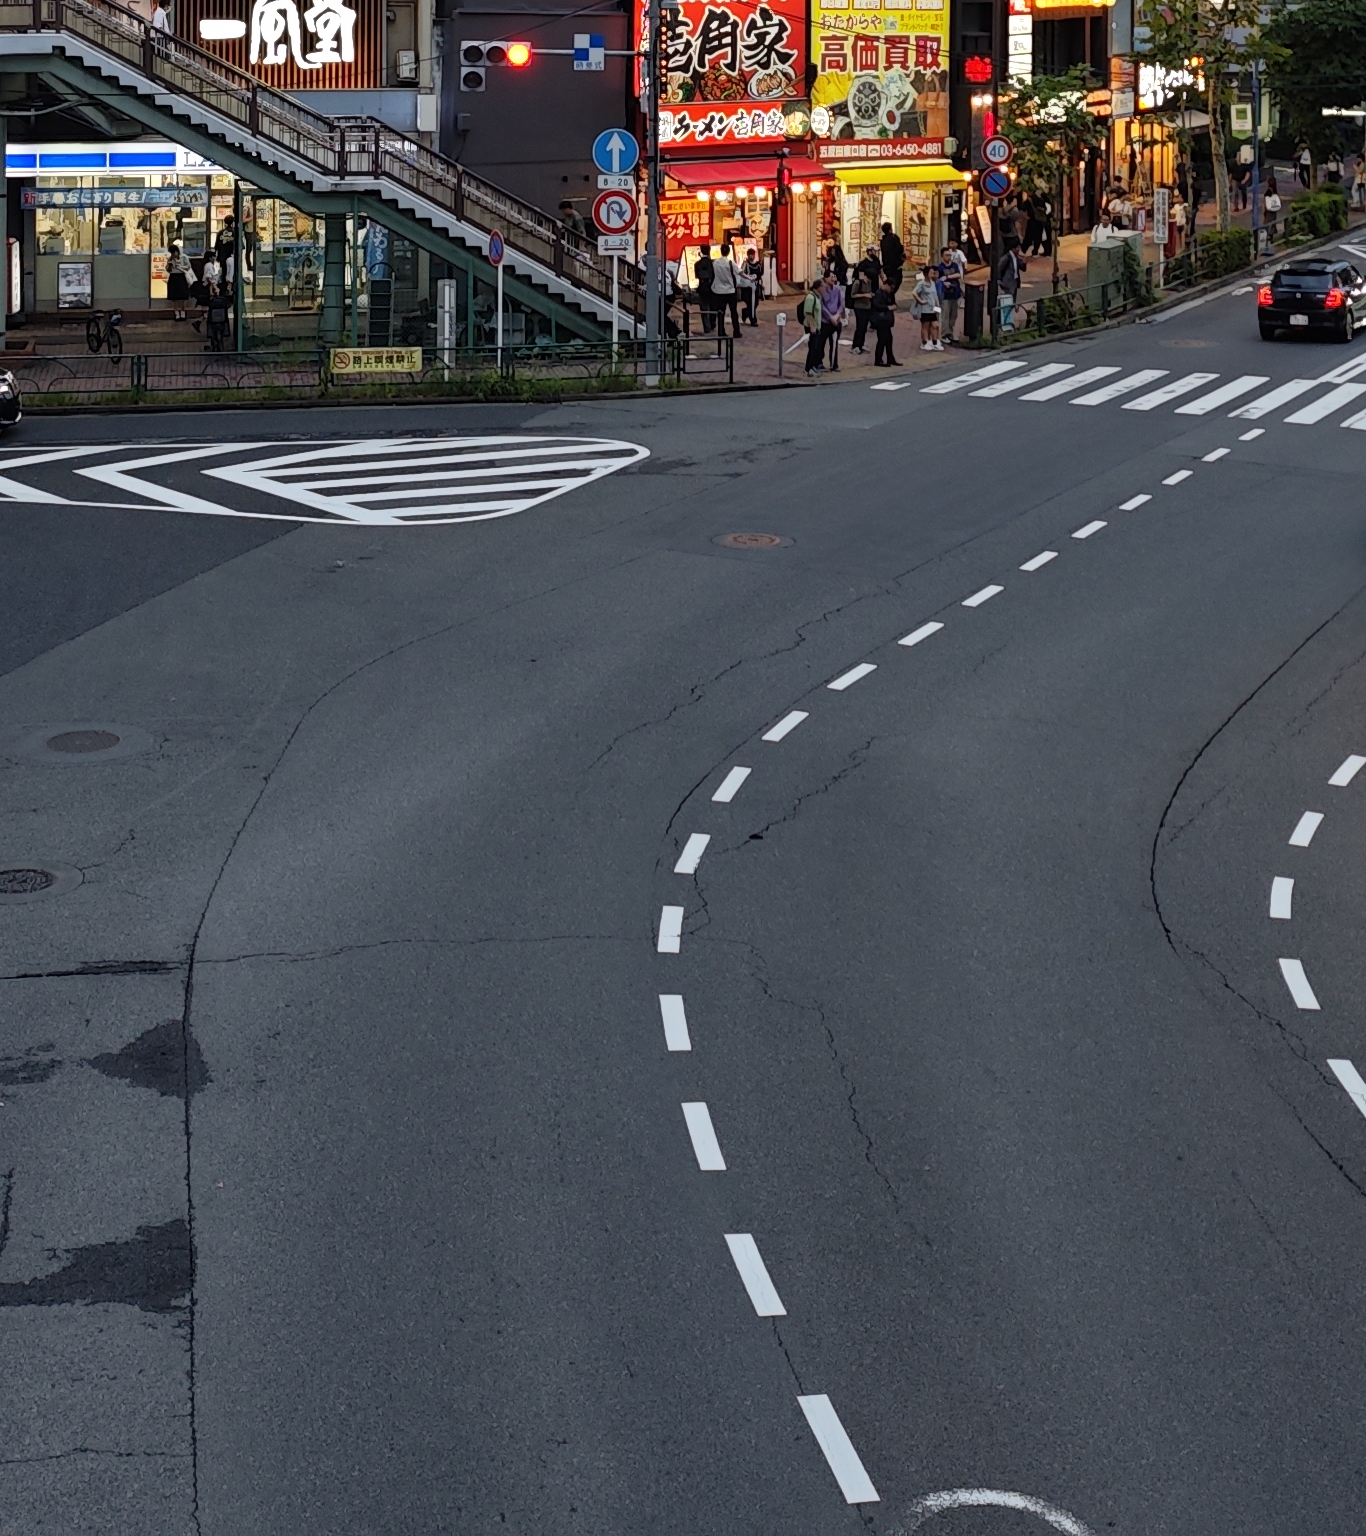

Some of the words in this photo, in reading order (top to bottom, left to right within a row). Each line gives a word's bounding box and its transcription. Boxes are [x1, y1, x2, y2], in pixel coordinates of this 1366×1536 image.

[820, 14, 882, 31] おたからや
[819, 34, 942, 74] 高価買取
[989, 145, 1006, 158] 40
